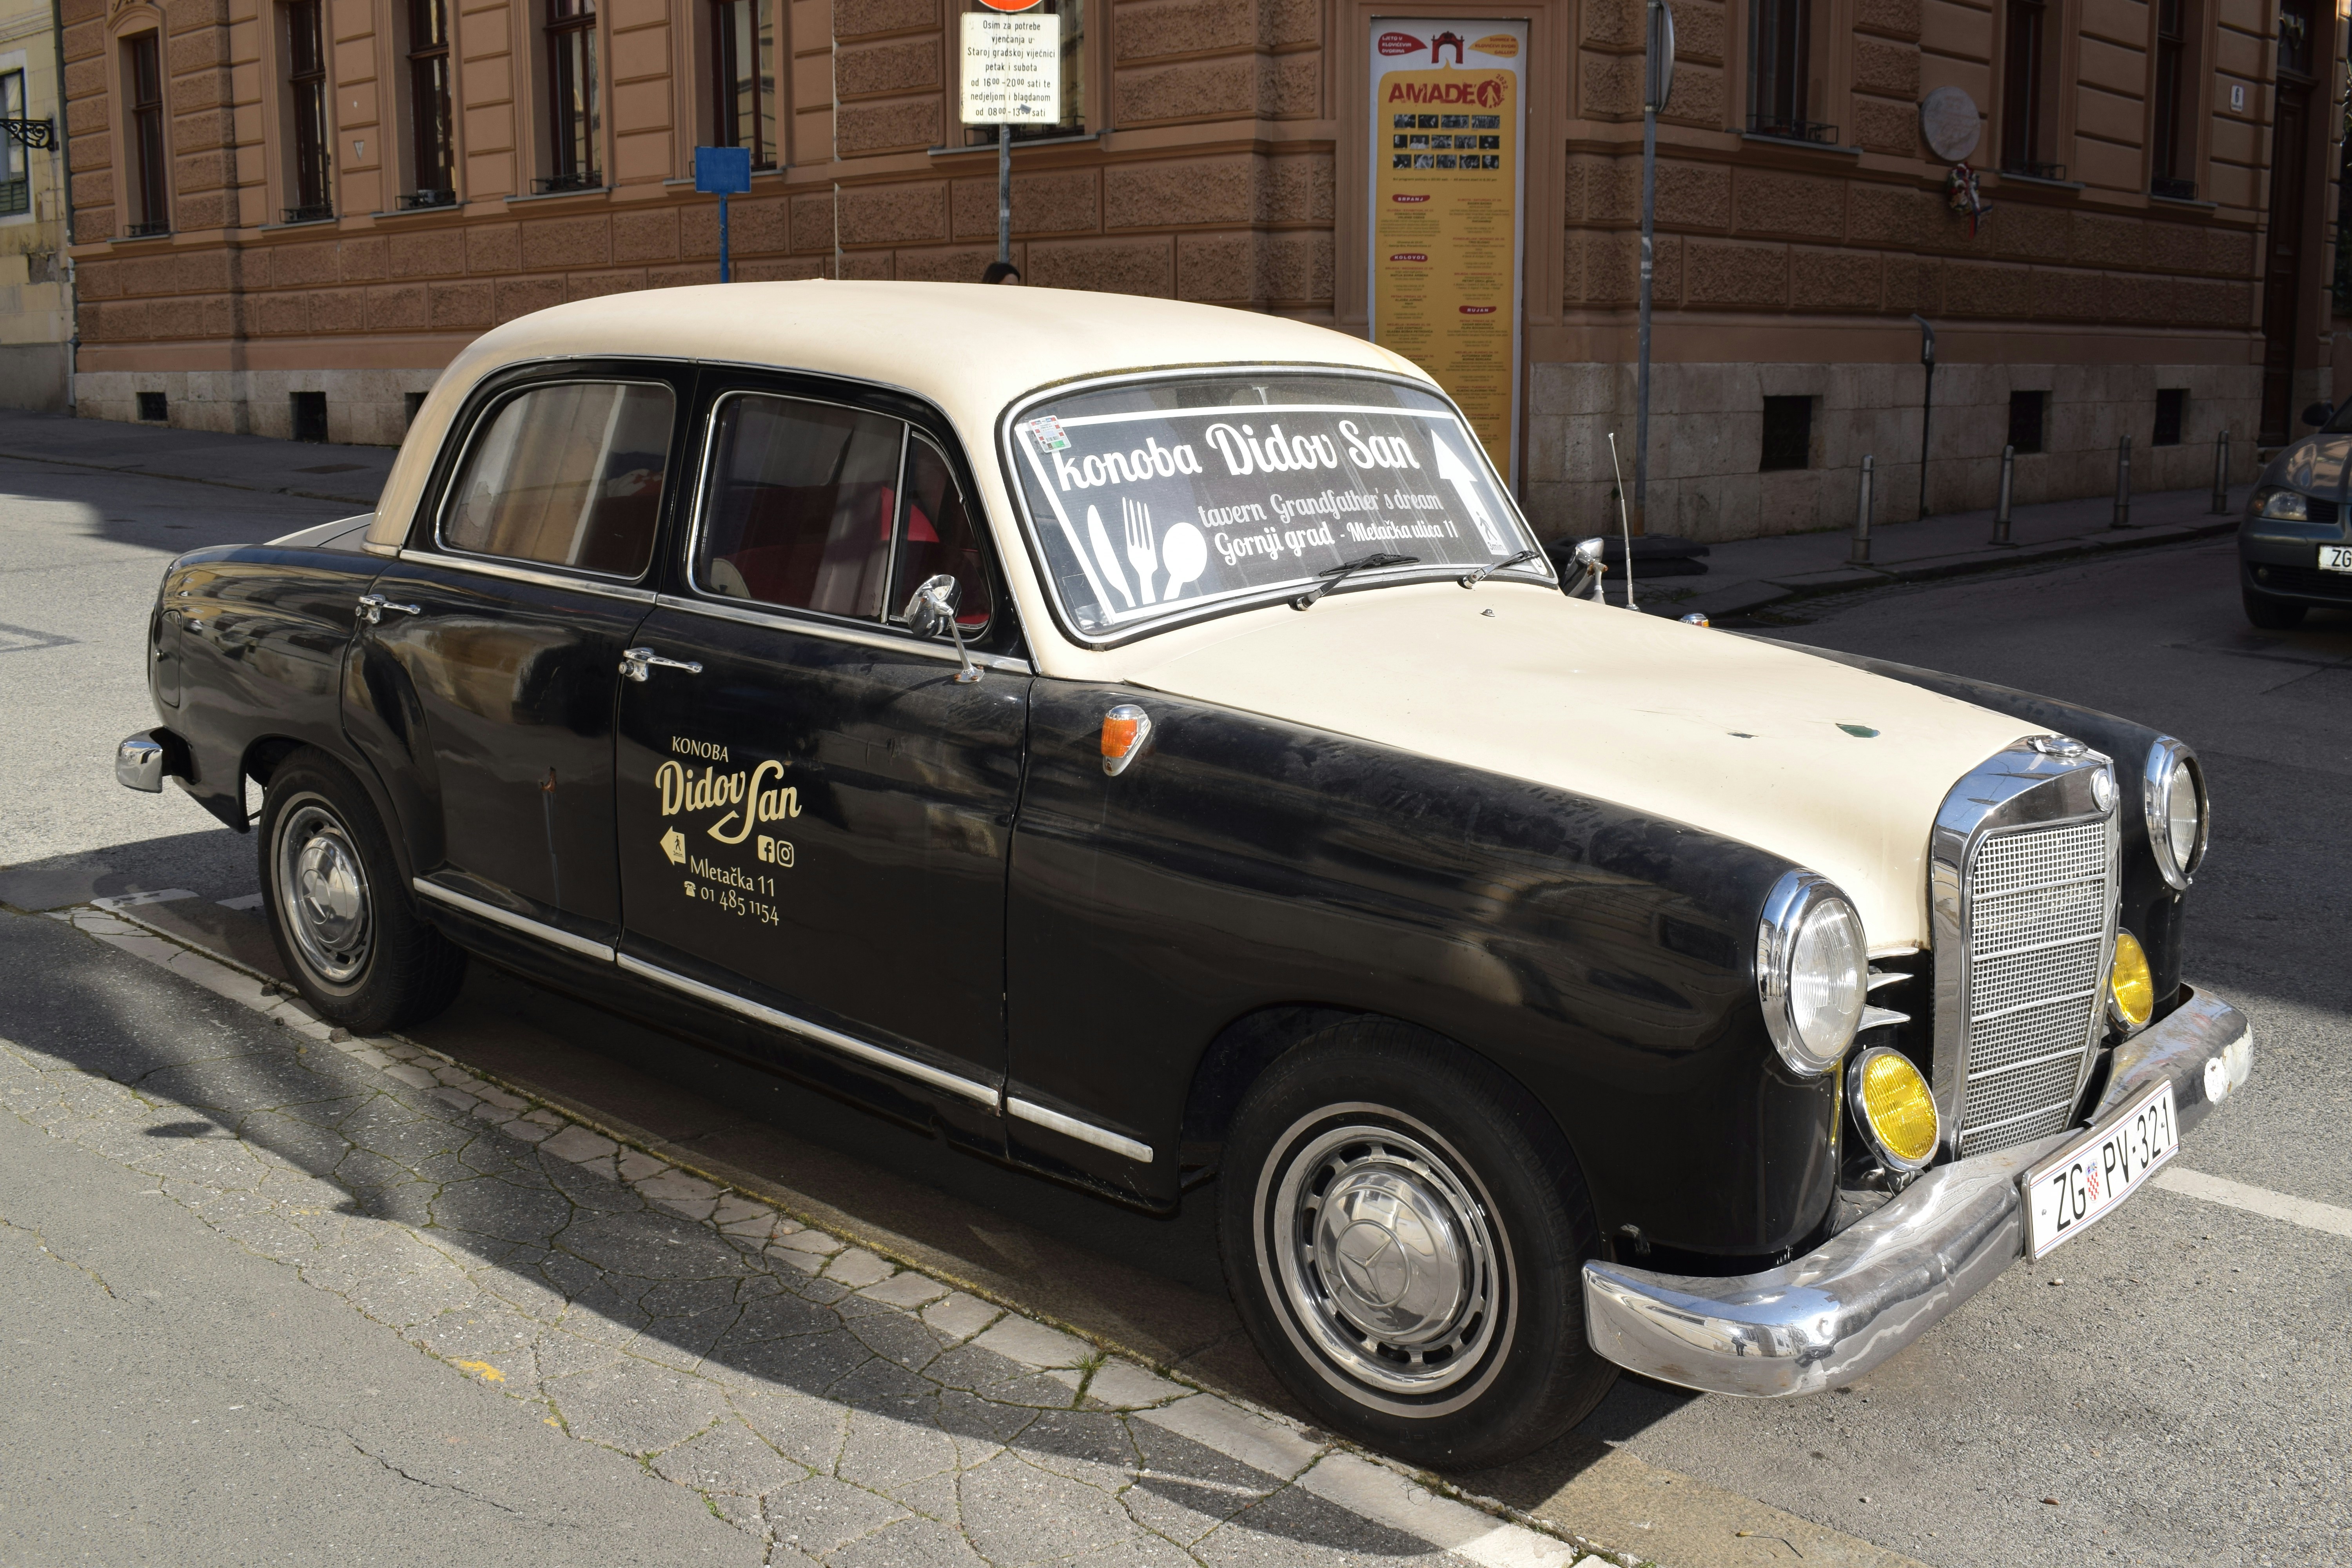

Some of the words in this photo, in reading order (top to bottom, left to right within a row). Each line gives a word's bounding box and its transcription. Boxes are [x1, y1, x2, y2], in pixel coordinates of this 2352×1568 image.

[983, 20, 1000, 29] Osim
[1014, 21, 1041, 32] potrebe
[967, 47, 990, 58] Staroj
[993, 49, 1023, 59] gradskoj
[1026, 49, 1055, 59] vijećnici
[985, 63, 1005, 73] petak
[1014, 63, 1037, 71] subota
[971, 78, 979, 87] od
[1027, 79, 1041, 87] sati
[1044, 80, 1051, 88] te
[971, 92, 1005, 102] nedjeljom
[1014, 93, 1051, 103] blagdanom
[2235, 87, 2239, 103] 6
[976, 107, 984, 116] od
[1032, 108, 1045, 117] sati
[1052, 437, 1202, 492] konoba
[1205, 422, 1337, 476] Didov
[1339, 420, 1420, 469] San
[1198, 502, 1267, 528] tavern
[1394, 488, 1444, 511] dream
[1214, 523, 1284, 566] Gornji
[1285, 520, 1335, 557] grad
[1347, 520, 1412, 542] Mletačka
[1412, 521, 1444, 539] ulica
[1446, 520, 1458, 538] 11
[2331, 550, 2352, 568] ZG
[672, 736, 729, 762] KONOBA
[655, 760, 745, 816] Didov
[707, 760, 802, 844] San
[690, 855, 754, 891] Mletačka
[758, 876, 774, 897] 11
[701, 887, 714, 902] 01
[720, 889, 745, 916] 485
[749, 901, 779, 926] 1154
[2053, 1163, 2086, 1232] ZG
[2102, 1097, 2171, 1199] PV-321
